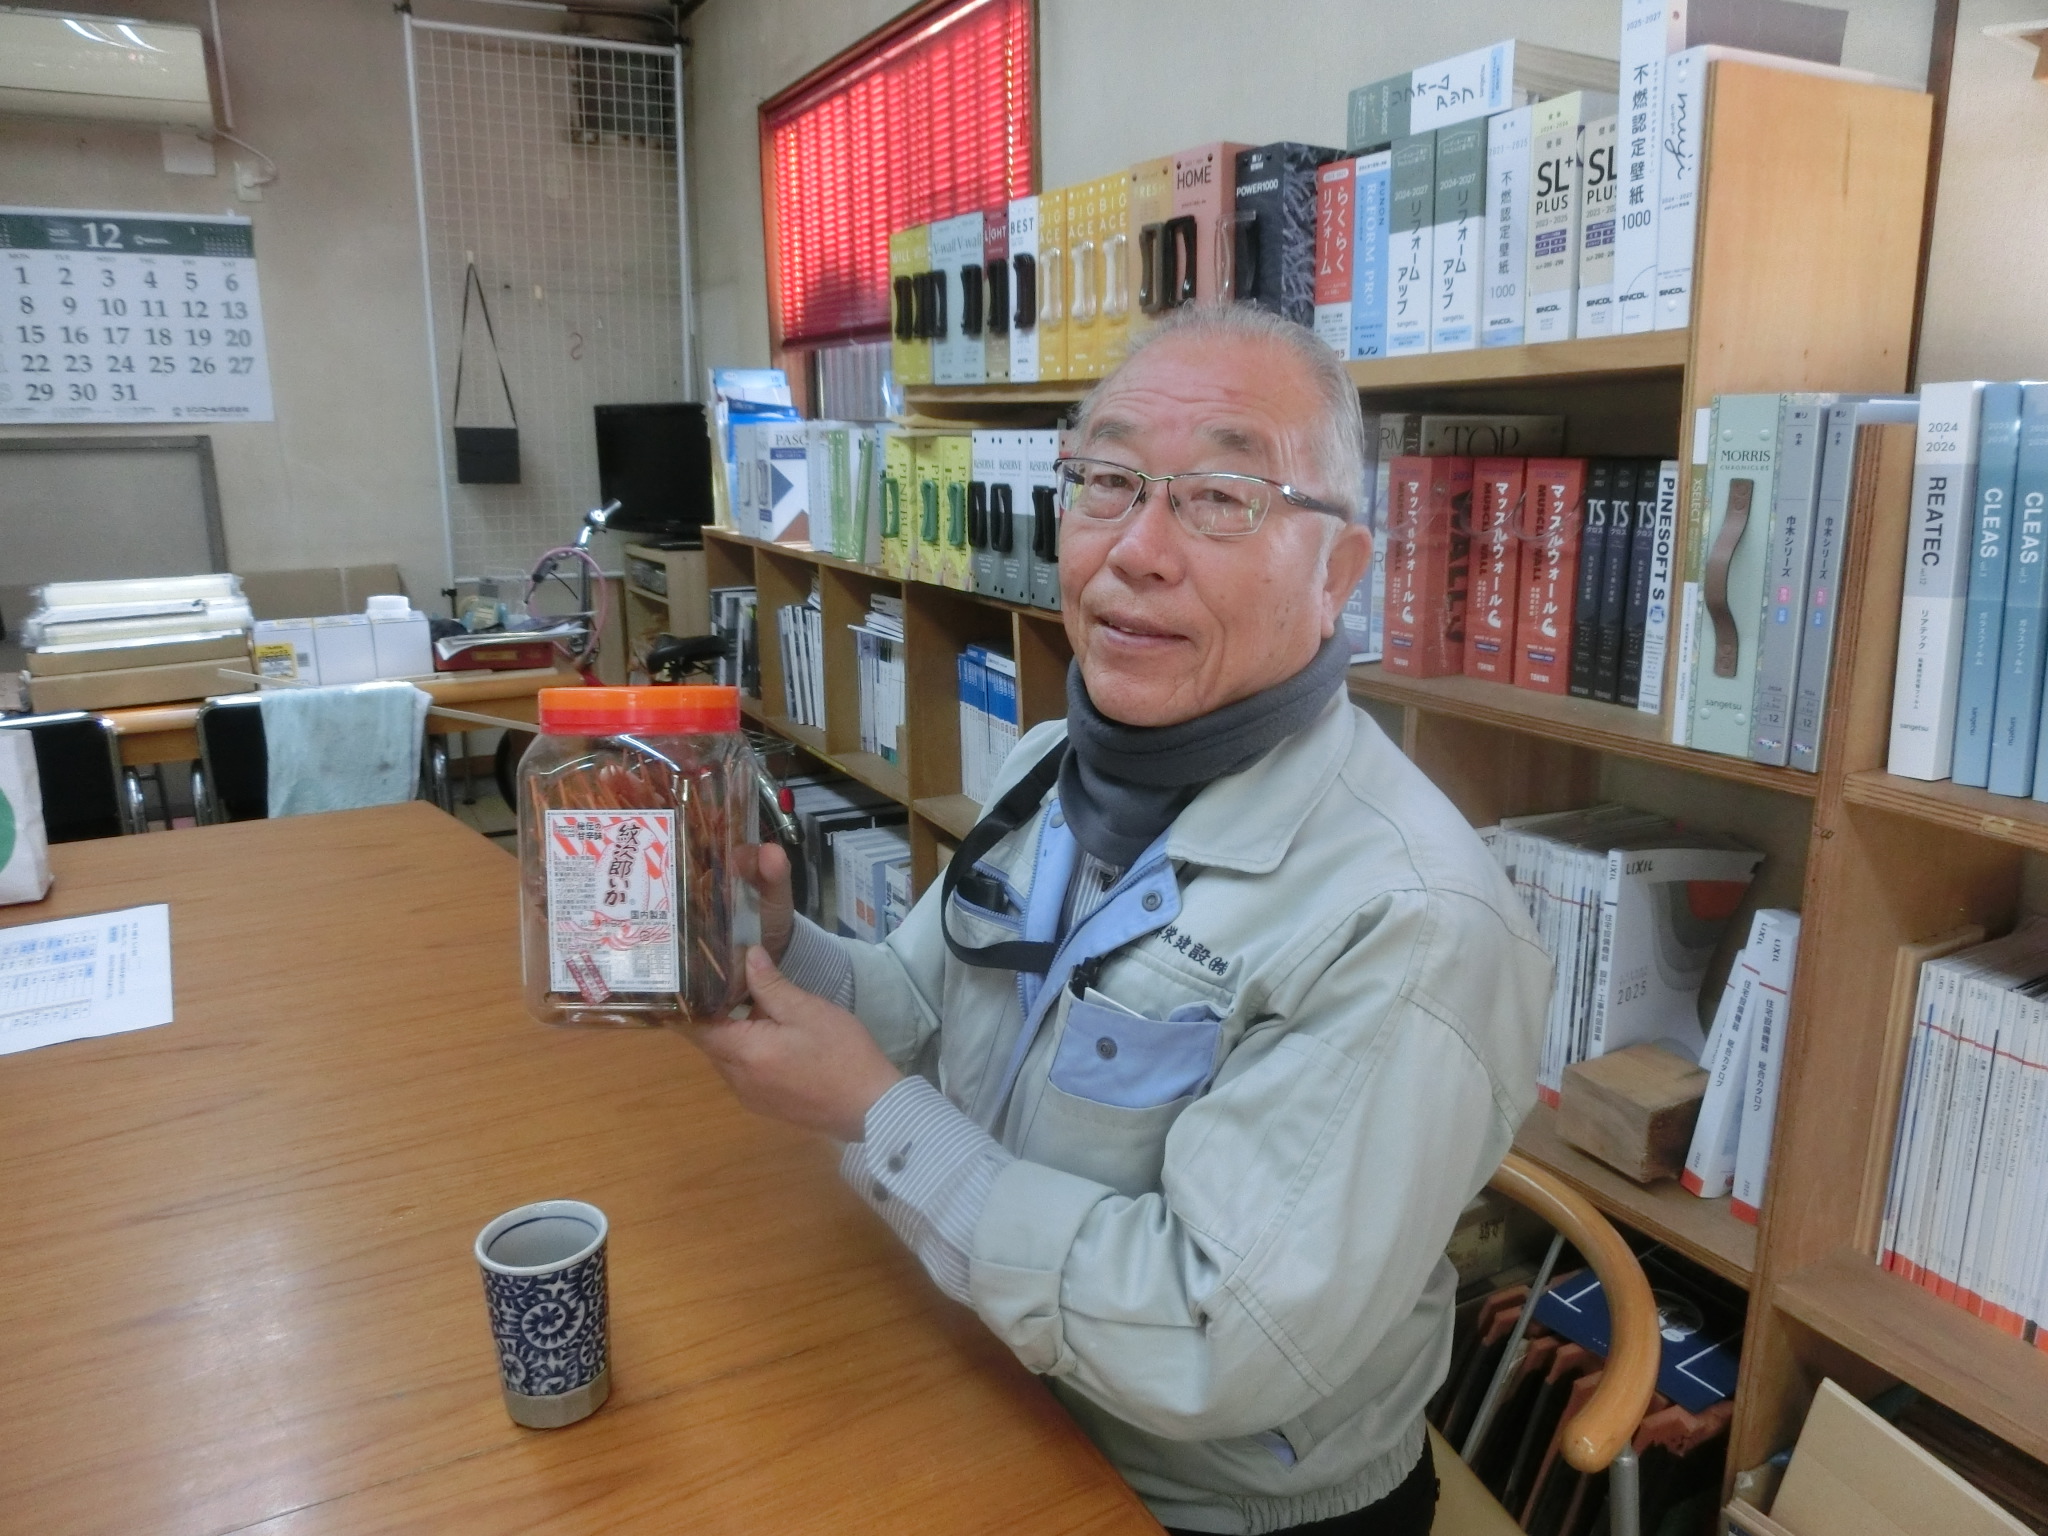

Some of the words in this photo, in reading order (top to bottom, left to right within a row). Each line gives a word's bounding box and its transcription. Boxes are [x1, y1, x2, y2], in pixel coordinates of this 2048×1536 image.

[1629, 63, 1649, 206] 不燃認定壁紙
[1177, 165, 1212, 190] HOME
[1236, 179, 1279, 198] POWER1000
[1068, 202, 1094, 219] BIG
[1100, 195, 1126, 211] BIG
[1536, 194, 1568, 216] PLUS
[1010, 218, 1034, 235] BEST
[1068, 222, 1094, 238] ACE
[1100, 212, 1126, 230] ACE
[1320, 189, 1332, 275] リフォーム
[1336, 186, 1348, 272] らくらく
[1455, 189, 1467, 272] リフォーム
[1499, 172, 1512, 274] 不燃認定壁紙
[1622, 209, 1651, 231] 1000
[82, 222, 124, 249] 12
[1409, 201, 1421, 280] リフォーム
[16, 266, 30, 285] 1
[58, 267, 74, 285] 2
[102, 269, 116, 287] 3
[143, 270, 158, 289] 4
[184, 272, 198, 290] 5
[225, 274, 239, 291] 6
[1443, 259, 1454, 309] アップ
[1398, 267, 1408, 315] アップ
[1490, 284, 1516, 299] 1000
[1587, 297, 1612, 307] SINCOL
[1619, 292, 1647, 303] SINCOL
[1659, 287, 1685, 296] SINCOL
[20, 296, 34, 314] 8
[62, 297, 77, 315] 9
[100, 298, 128, 316] 10
[141, 300, 169, 317] 11
[184, 301, 209, 318] 12
[223, 302, 249, 319] 13
[1536, 305, 1560, 313] SINCOL
[18, 325, 45, 344] 15
[60, 326, 89, 344] 16
[104, 327, 130, 344] 17
[146, 328, 173, 346] 18
[187, 329, 212, 346] 19
[225, 329, 251, 347] 20
[21, 354, 51, 372] 22
[64, 355, 94, 372] 23
[108, 355, 136, 373] 24
[150, 356, 176, 373] 25
[189, 356, 216, 374] 26
[228, 357, 255, 374] 27
[25, 383, 54, 401] 29
[69, 383, 97, 401] 30
[112, 383, 139, 401] 31
[1928, 423, 1958, 433] 2024
[1721, 450, 1770, 462] MORRIS
[1926, 442, 1956, 452] 2026
[1588, 499, 1605, 526] TS
[1691, 479, 1703, 523] XSELECT
[1612, 501, 1629, 528] TS
[1637, 501, 1655, 528] TS
[1922, 477, 1948, 567] REATEC
[1980, 487, 2003, 558] CLEAS
[1586, 526, 1603, 534] クロス
[1656, 477, 1676, 582] PINESOFT
[2020, 492, 2044, 564] CLEAS
[1782, 516, 1796, 577] 巾木シリーズ
[1819, 516, 1833, 579] 巾木シリーズ
[1652, 588, 1665, 600] S
[1919, 610, 1929, 650] リアテック
[1975, 612, 1988, 666] ガラスフィルム
[2013, 619, 2027, 674] ガラスフィルム
[1705, 699, 1742, 711] sangetsu
[1900, 723, 1929, 732] sangetsu
[1970, 707, 1978, 735] sangetsu
[2007, 717, 2016, 746] sangetsu
[577, 822, 600, 831] 秘伝の
[604, 824, 641, 906] 紋次郎いか
[1609, 859, 1617, 881] LIXIL
[1626, 859, 1654, 876] LIXIL
[631, 910, 668, 919] 国内製造
[1756, 922, 1767, 946] LIXIL
[1772, 938, 1781, 962] LIXIL
[1617, 980, 1647, 1005] 2025
